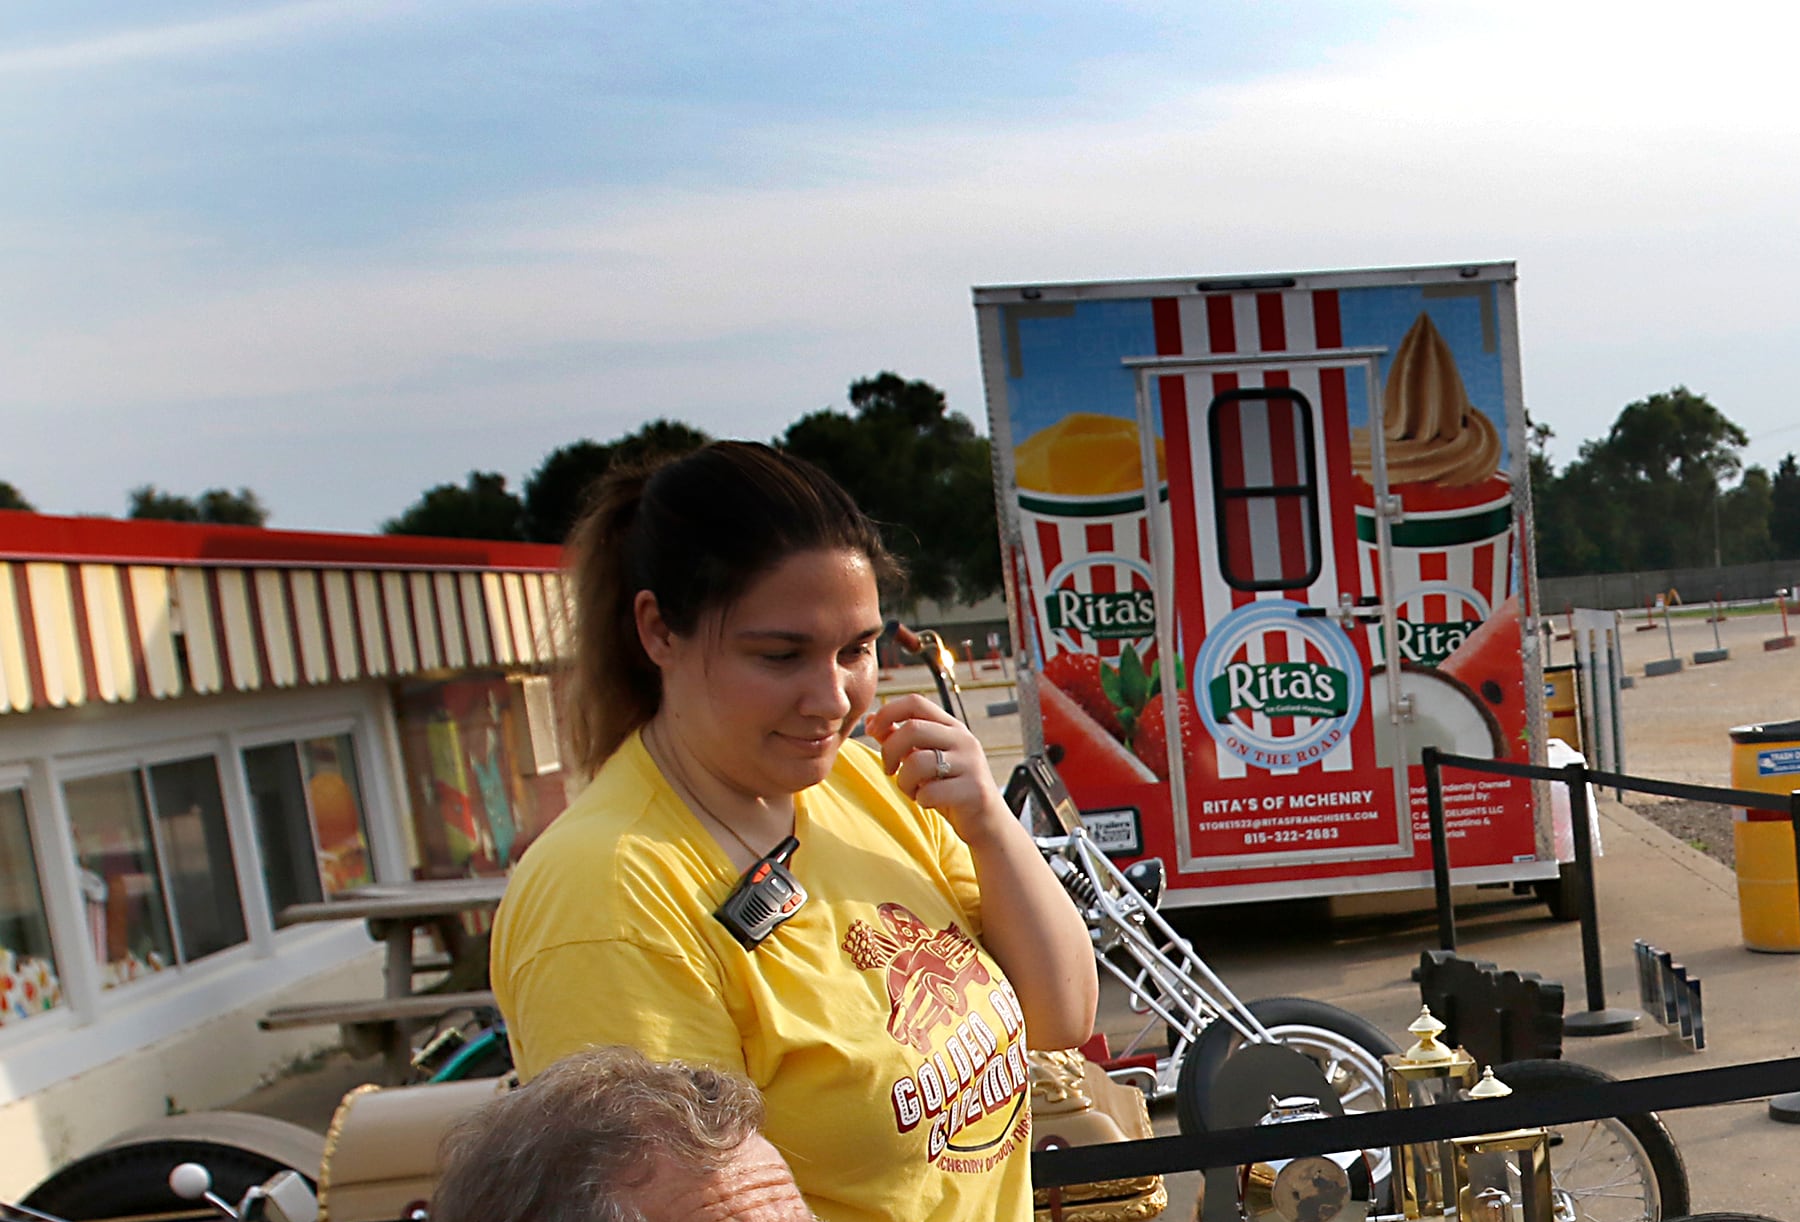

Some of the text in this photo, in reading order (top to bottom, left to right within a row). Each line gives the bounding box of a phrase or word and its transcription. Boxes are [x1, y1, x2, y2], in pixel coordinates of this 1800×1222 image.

[1059, 590, 1154, 632] Rita's
[1227, 663, 1336, 709] Rita's
[1226, 730, 1342, 765] ON THE ROAD
[1203, 790, 1374, 814] RITA'S OF MCHENRY
[1478, 780, 1511, 790] Owned
[1489, 805, 1504, 814] LLC
[893, 1010, 998, 1128] GOLDEN
